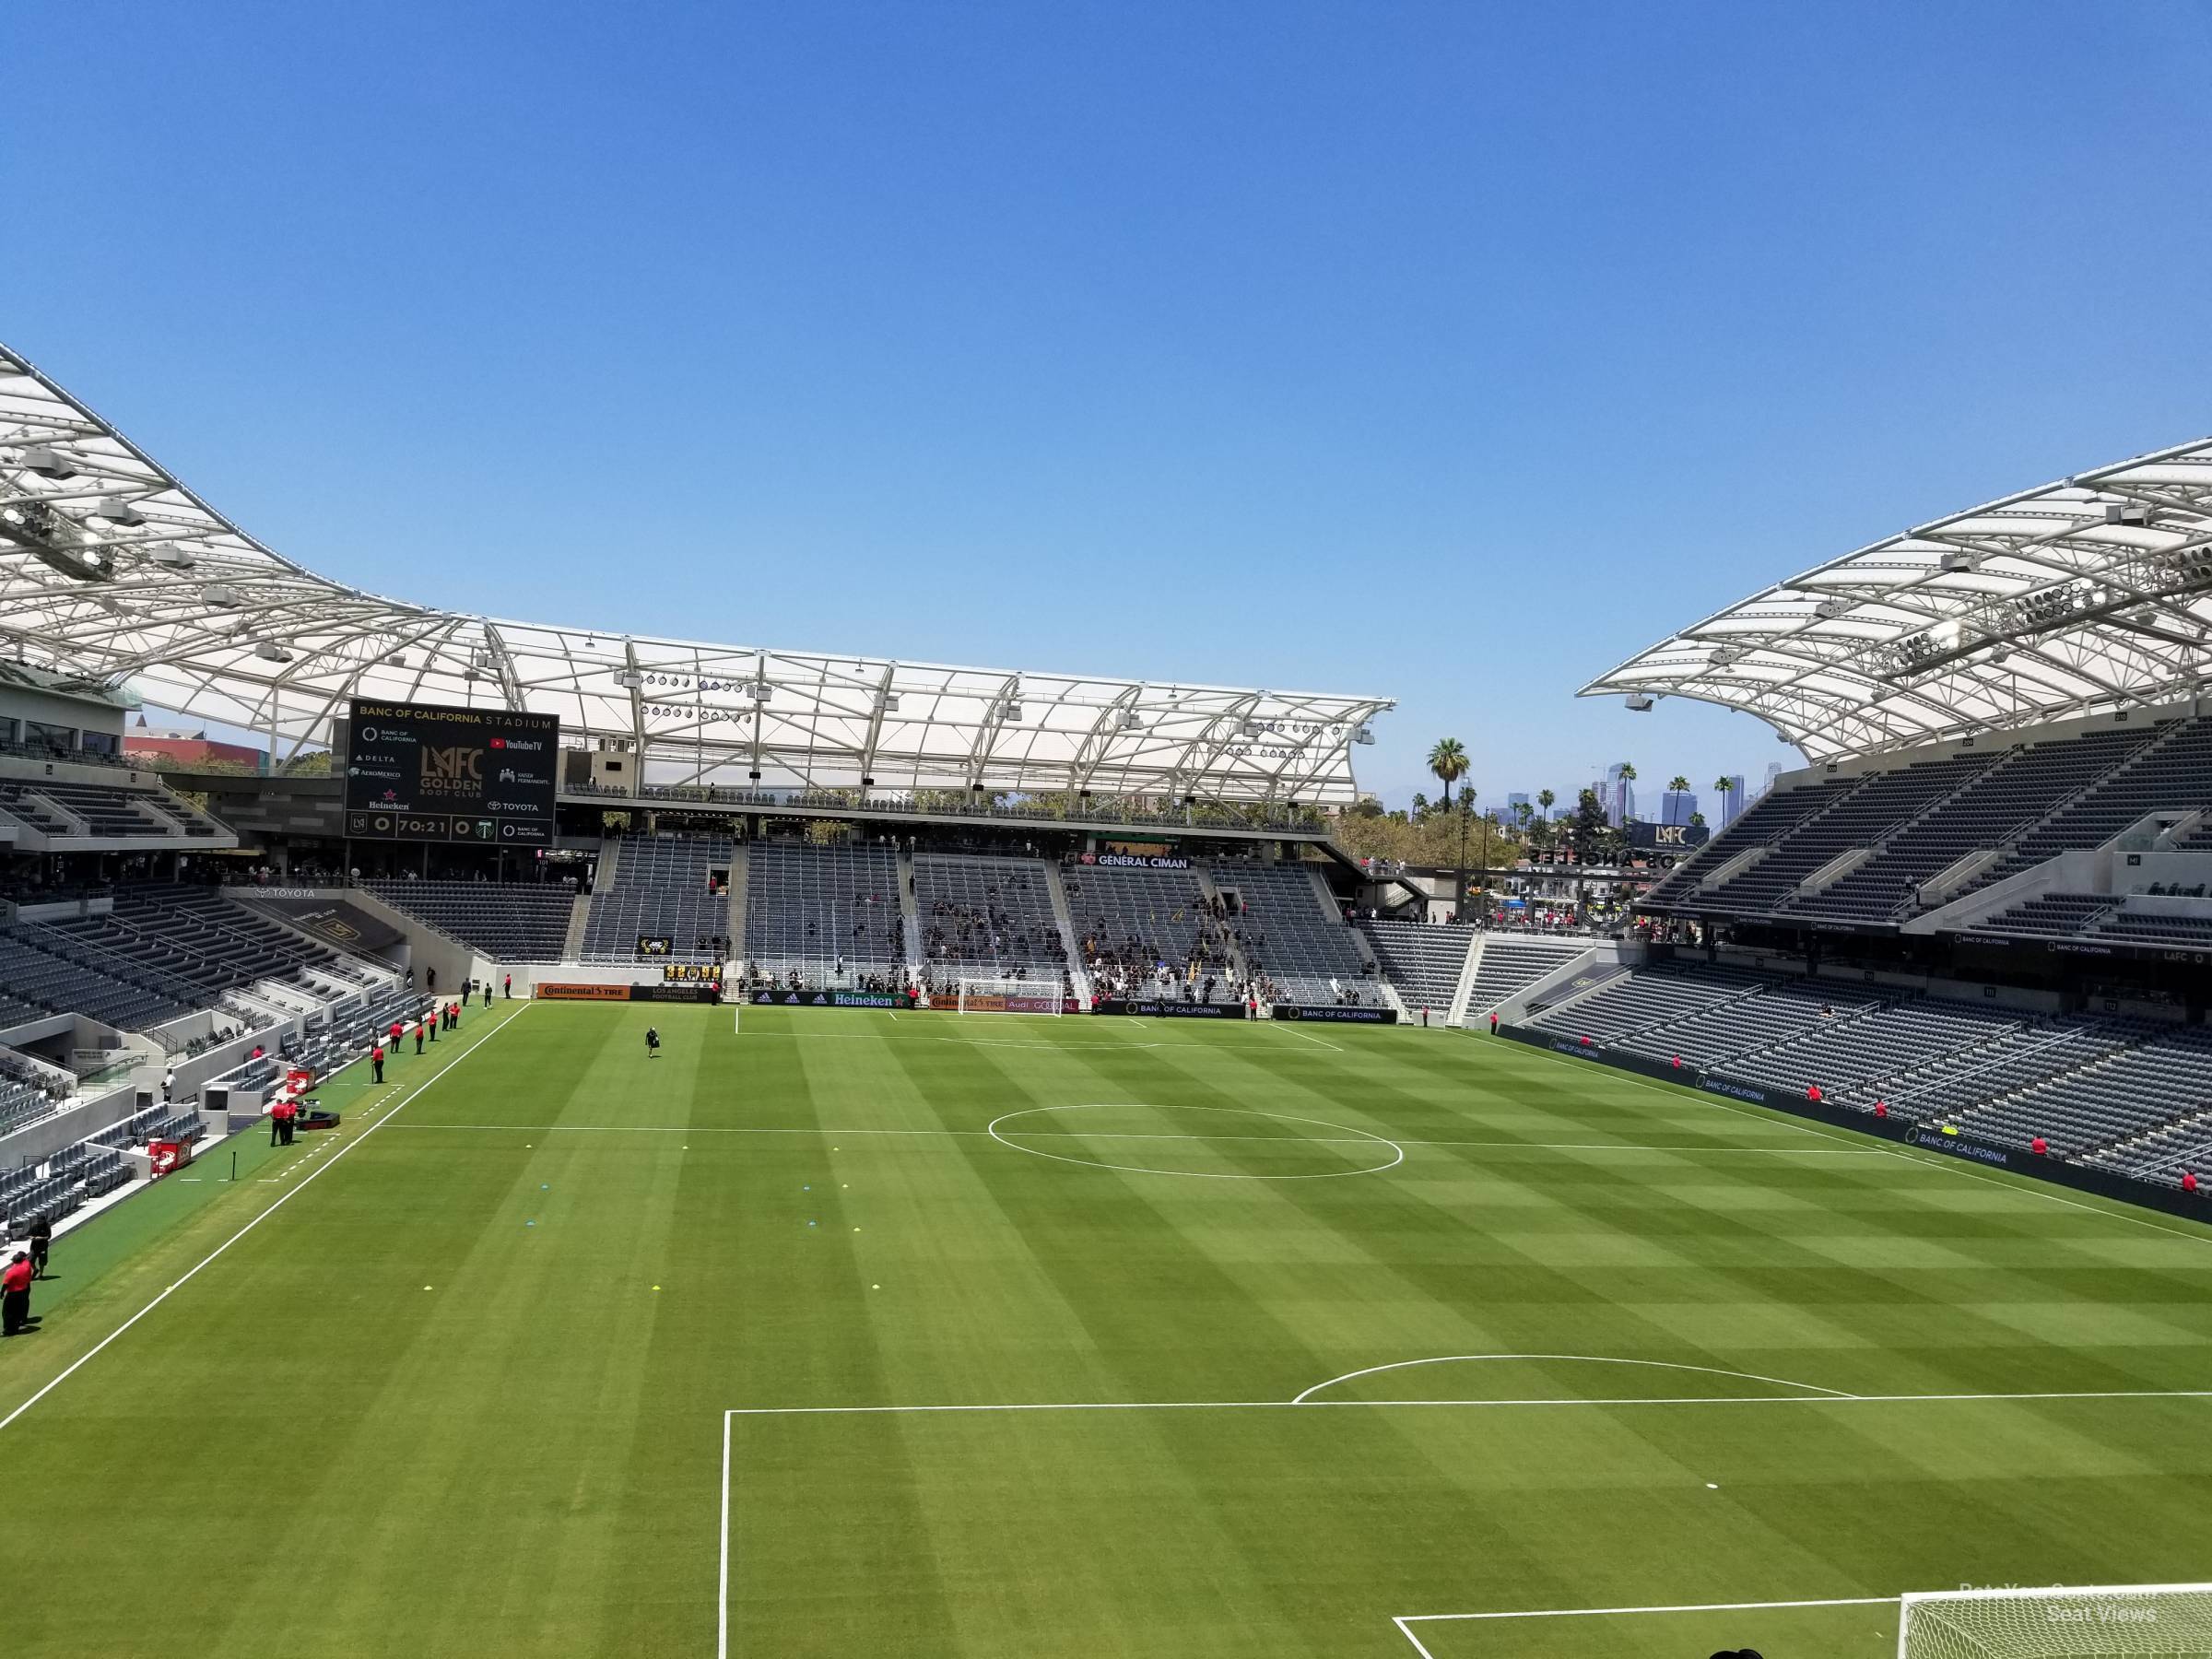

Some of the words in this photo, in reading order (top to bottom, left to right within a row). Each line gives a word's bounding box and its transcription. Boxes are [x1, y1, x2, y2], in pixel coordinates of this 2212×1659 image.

[359, 706, 393, 717] BANC
[395, 709, 412, 718] OF
[414, 711, 481, 724] CALIFORNIA
[486, 716, 551, 729] STADIUM
[365, 754, 395, 763] DELTA
[420, 745, 484, 780] LAFC
[420, 778, 481, 791] GOLDEN
[419, 788, 449, 797] BOOT
[454, 790, 482, 798] CLUB
[369, 801, 409, 810] Heineken
[502, 803, 539, 811] TOYOTA
[398, 819, 446, 833] 70:21
[1655, 824, 1687, 844] LAFC
[1150, 857, 1187, 868] CIMAN
[273, 888, 315, 898] TOYOTA
[2164, 951, 2188, 961] LAFC
[545, 985, 594, 996] Continental
[666, 987, 699, 995] ANGELES
[835, 994, 893, 1006] Heineken
[1176, 1006, 1221, 1015] CALIFORNIA
[1337, 1011, 1381, 1019] CALIFORNIA
[1705, 1079, 1723, 1090] BANC
[1722, 1083, 1732, 1092] OF
[1731, 1086, 1765, 1101] CALIFORNIA
[1920, 1134, 1943, 1147] BANC
[1943, 1140, 1957, 1150] OF
[1957, 1143, 2006, 1164] CALIFORNIA
